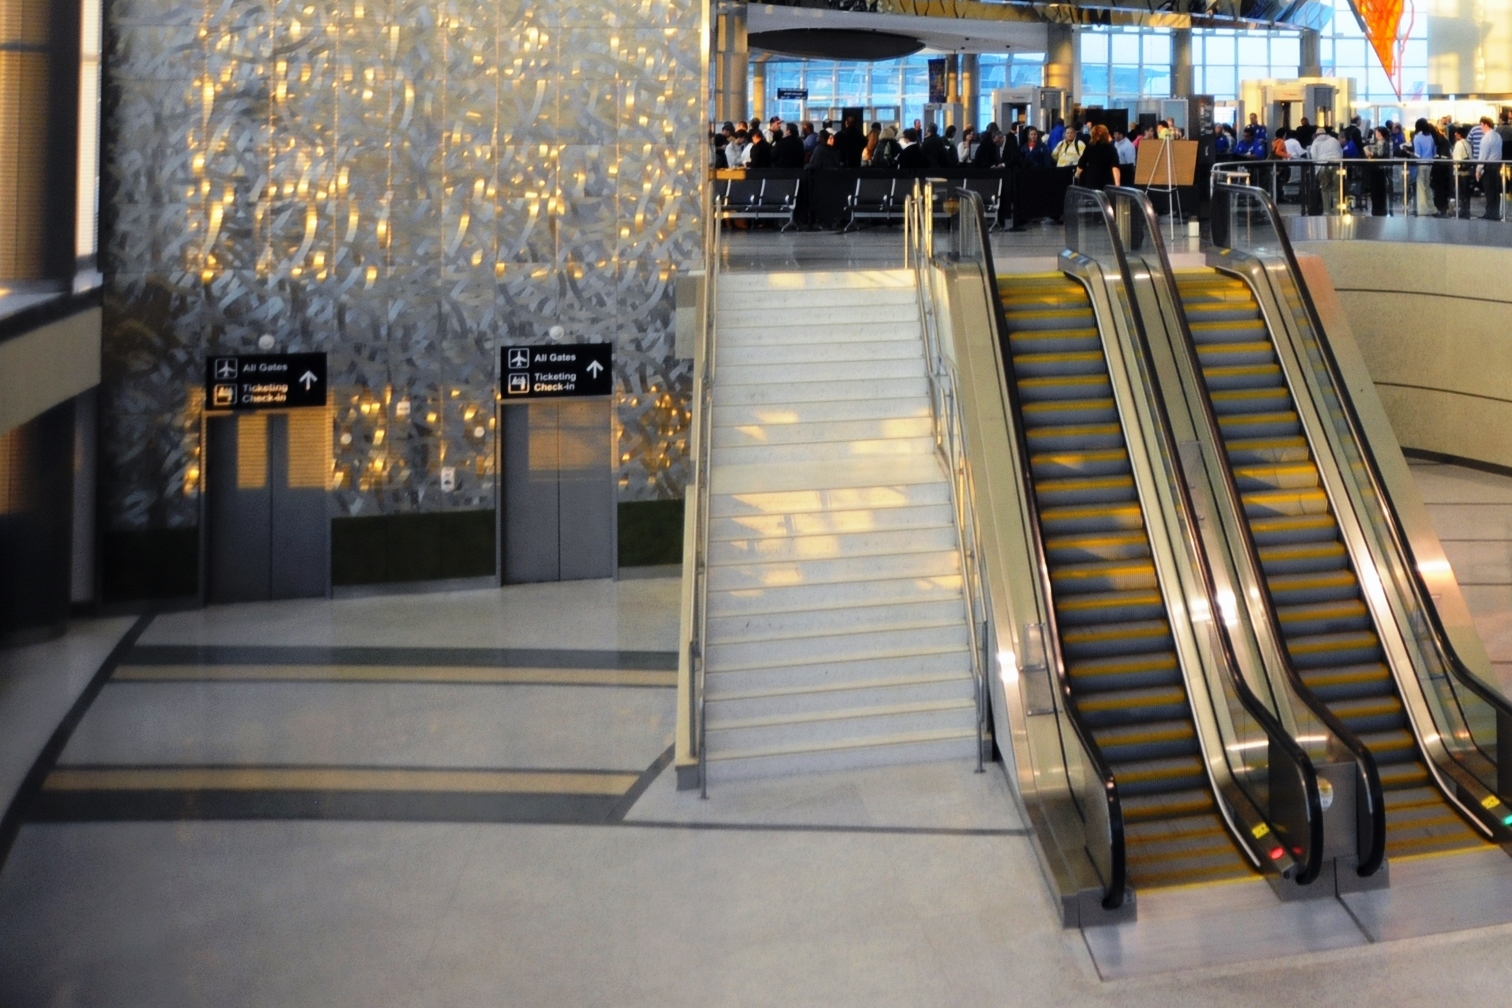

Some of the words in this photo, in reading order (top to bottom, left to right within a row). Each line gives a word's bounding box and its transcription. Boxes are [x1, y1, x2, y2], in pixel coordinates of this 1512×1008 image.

[534, 353, 548, 362] All
[549, 353, 577, 362] Gates
[242, 363, 257, 372] All
[259, 363, 288, 372] Gates
[535, 372, 577, 382] Ticketing
[243, 383, 289, 393] Ticketing
[533, 382, 575, 392] Check-in
[242, 393, 287, 403] Check-in
